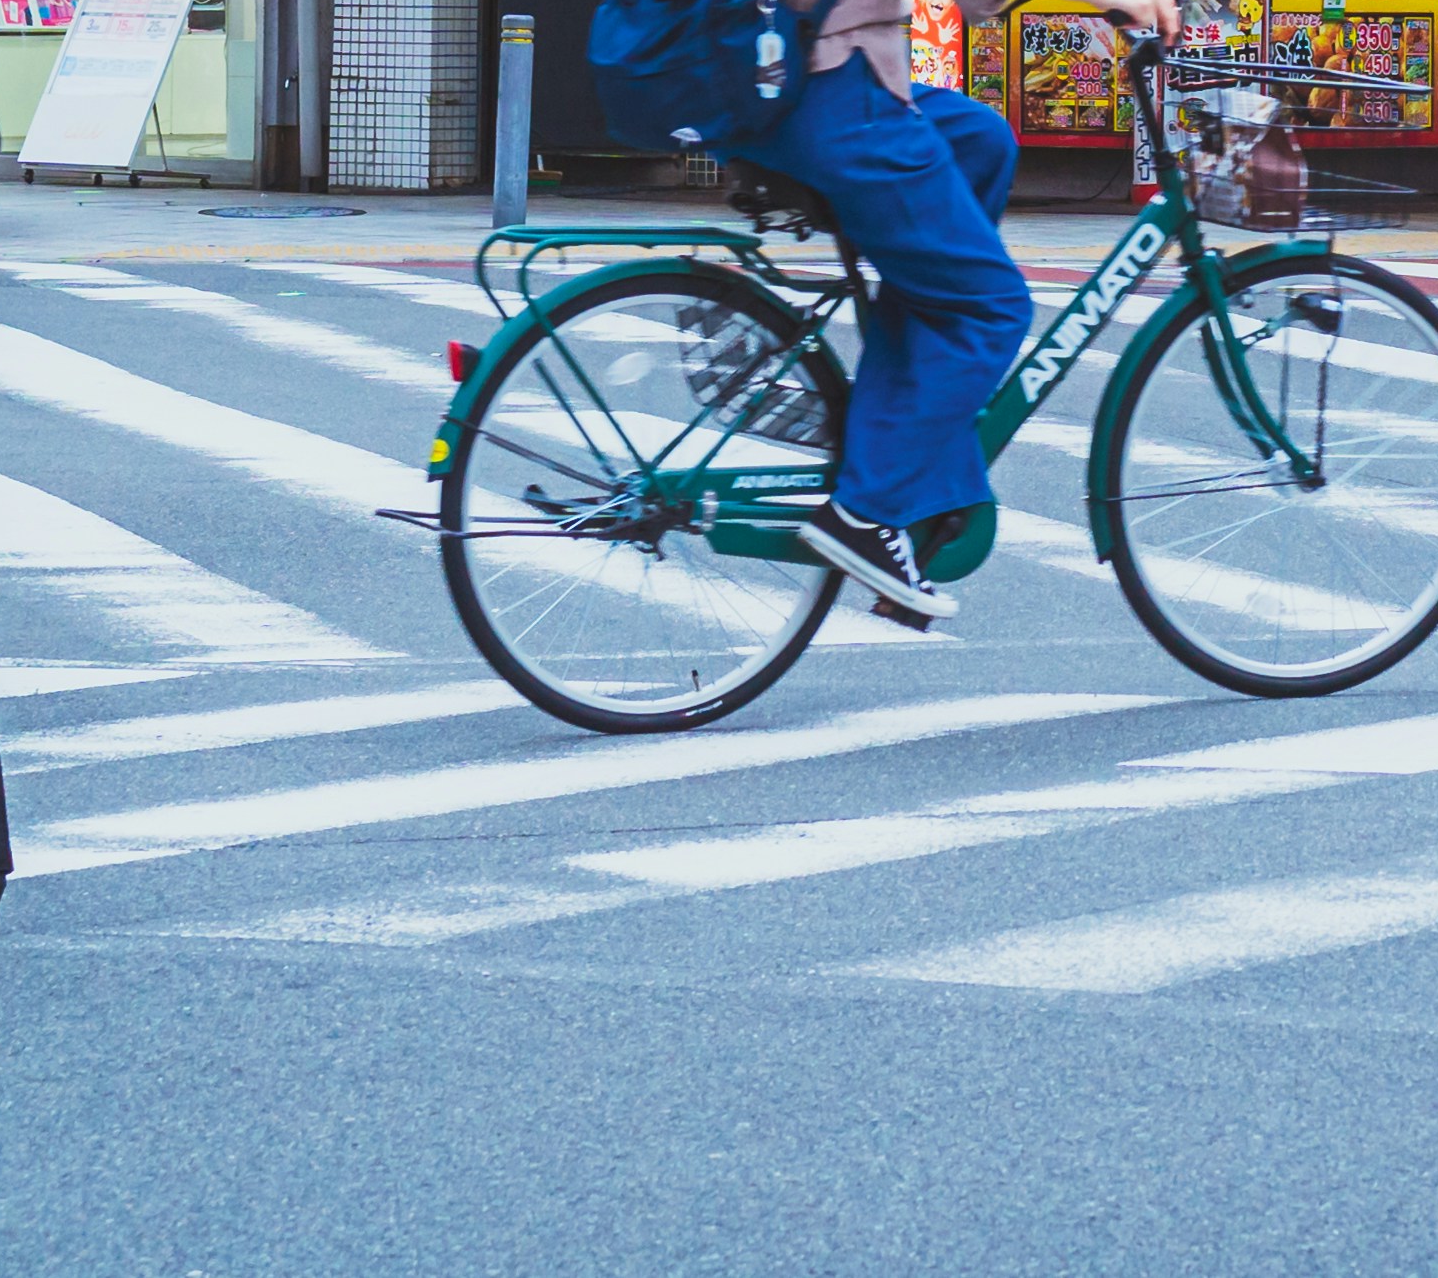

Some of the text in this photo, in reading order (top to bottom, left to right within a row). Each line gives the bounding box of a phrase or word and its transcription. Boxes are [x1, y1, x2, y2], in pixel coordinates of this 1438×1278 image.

[1023, 23, 1093, 56] 焼そば
[1019, 223, 1166, 404] ANIMATO
